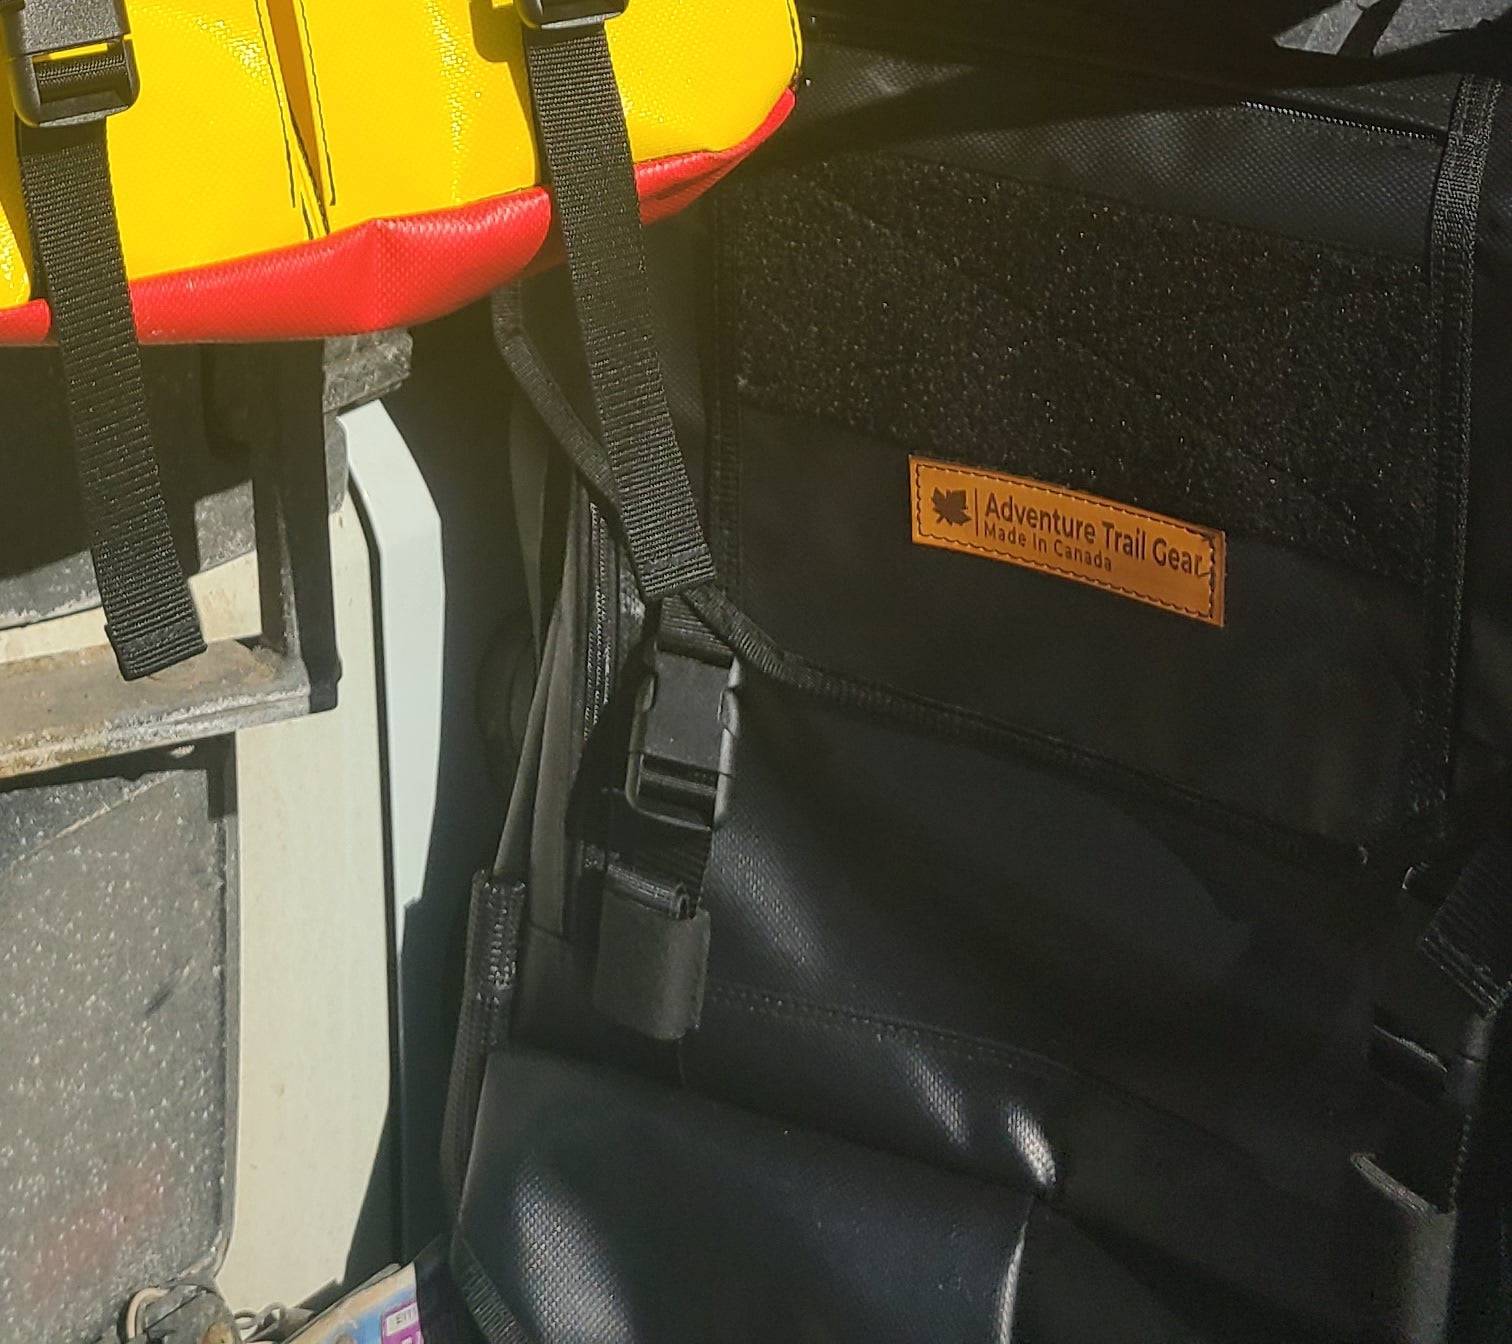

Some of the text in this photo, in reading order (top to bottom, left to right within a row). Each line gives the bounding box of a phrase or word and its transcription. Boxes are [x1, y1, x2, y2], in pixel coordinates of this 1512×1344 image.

[984, 492, 1203, 575] Adventure Trail Gear
[984, 520, 1027, 548] Made
[1053, 539, 1112, 573] Canada
